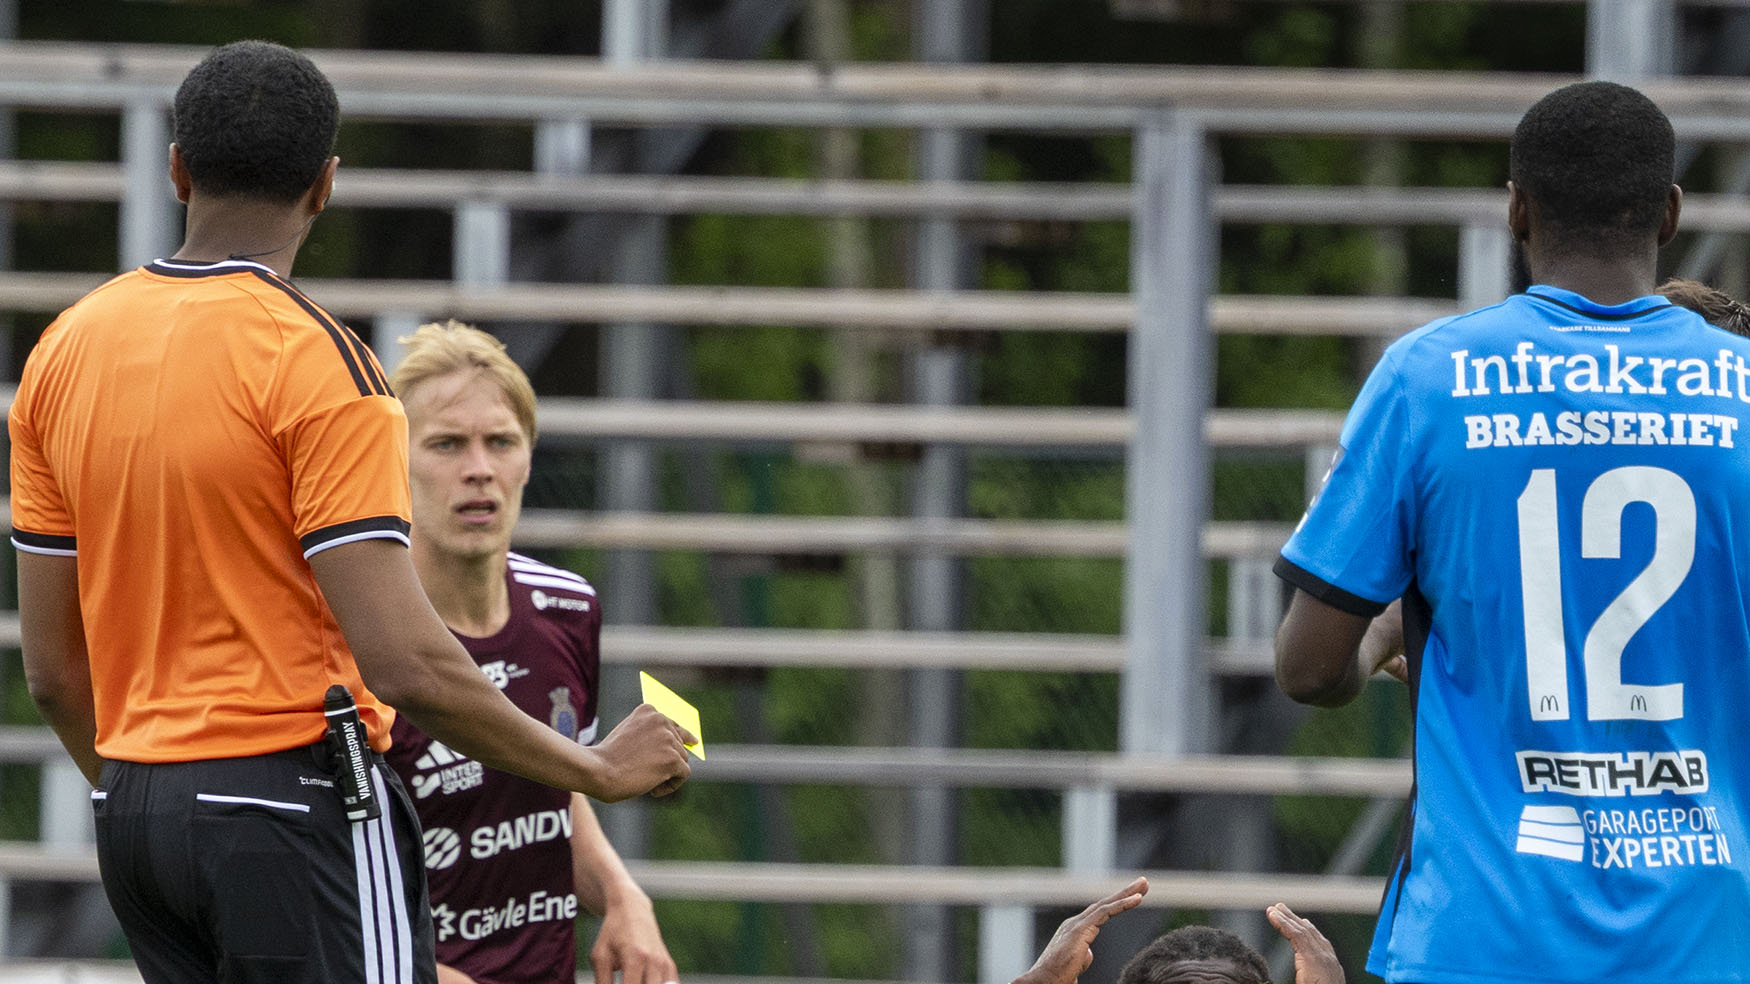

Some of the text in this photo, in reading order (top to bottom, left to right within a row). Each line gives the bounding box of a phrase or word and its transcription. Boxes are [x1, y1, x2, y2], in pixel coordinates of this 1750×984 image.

[1465, 411, 1738, 449] BRASSERIET
[1517, 465, 1697, 722] 12
[342, 722, 371, 800] VANISHINGSPRAY
[1522, 754, 1706, 793] RETHAB
[1583, 806, 1720, 836] GARAGEPORT
[1590, 833, 1732, 869] EXPERTEN
[459, 897, 526, 941] Gävle
